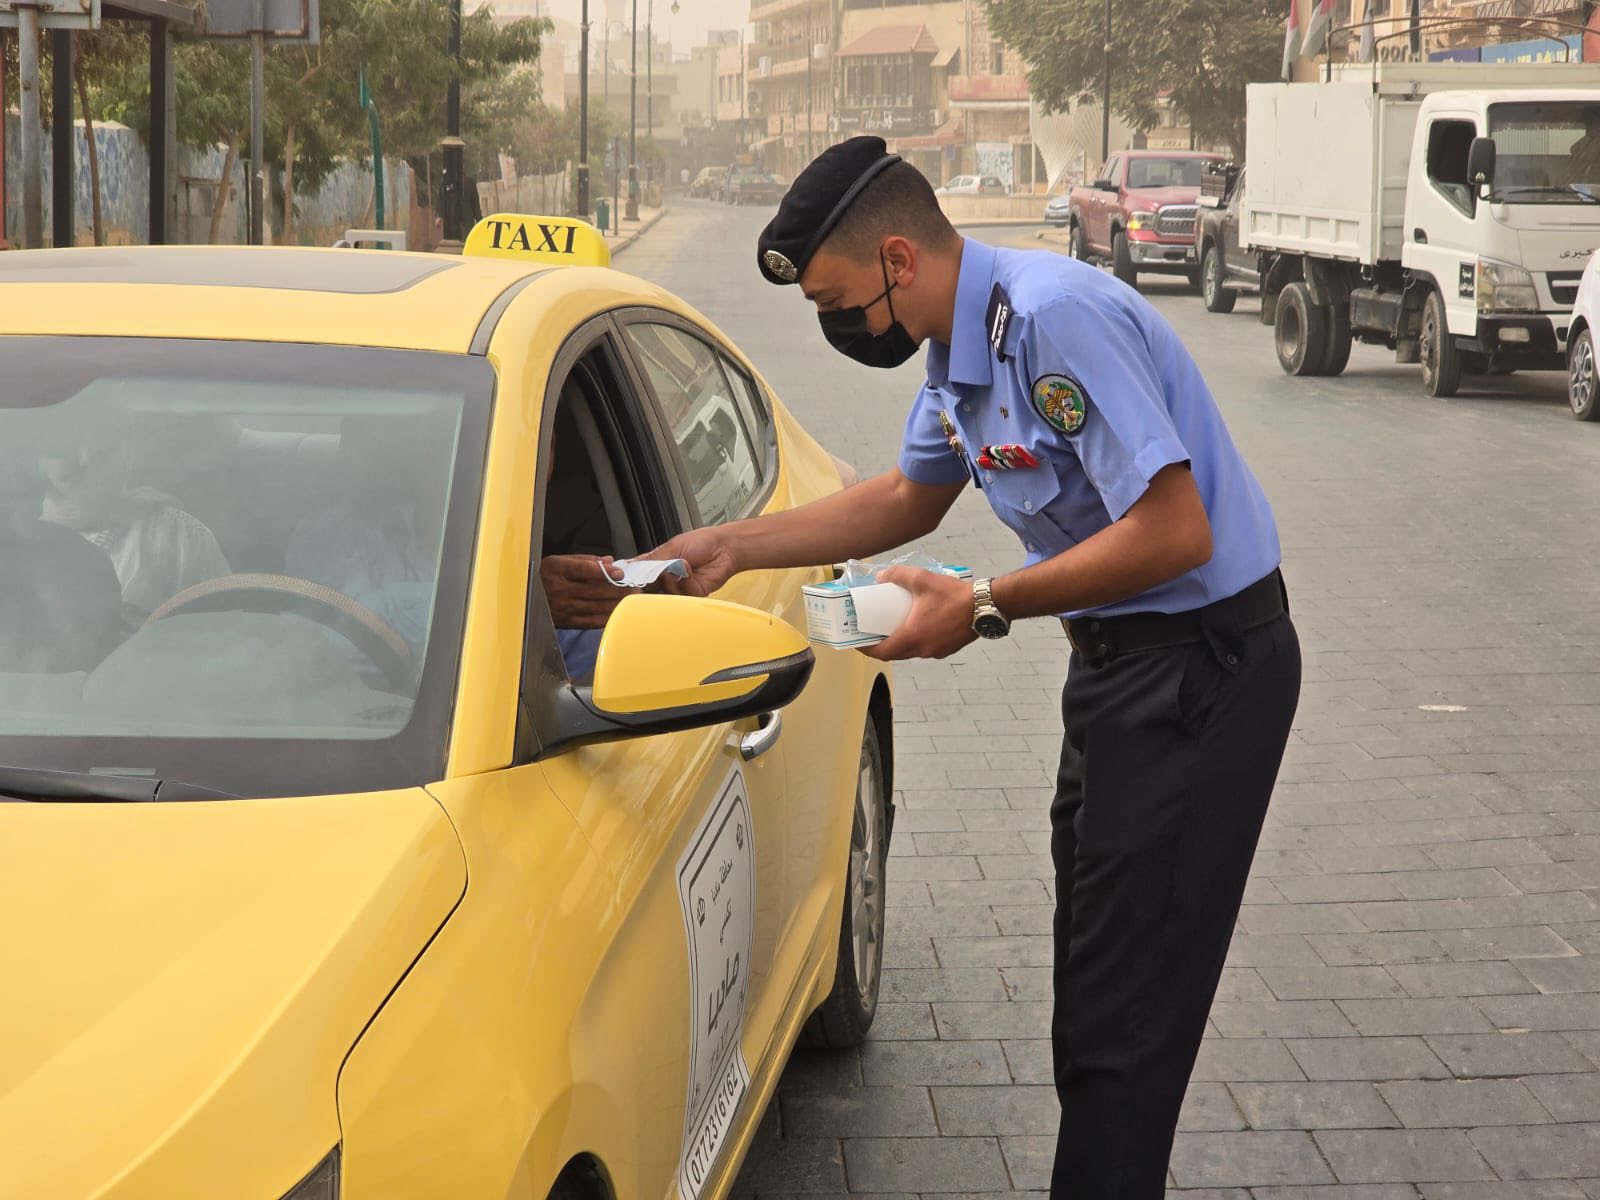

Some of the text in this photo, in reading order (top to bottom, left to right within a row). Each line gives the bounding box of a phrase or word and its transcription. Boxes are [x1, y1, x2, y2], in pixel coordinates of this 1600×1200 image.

[486, 221, 579, 254] TAXI
[707, 952, 740, 1037] مادبا
[691, 1062, 738, 1184] 0772316162
